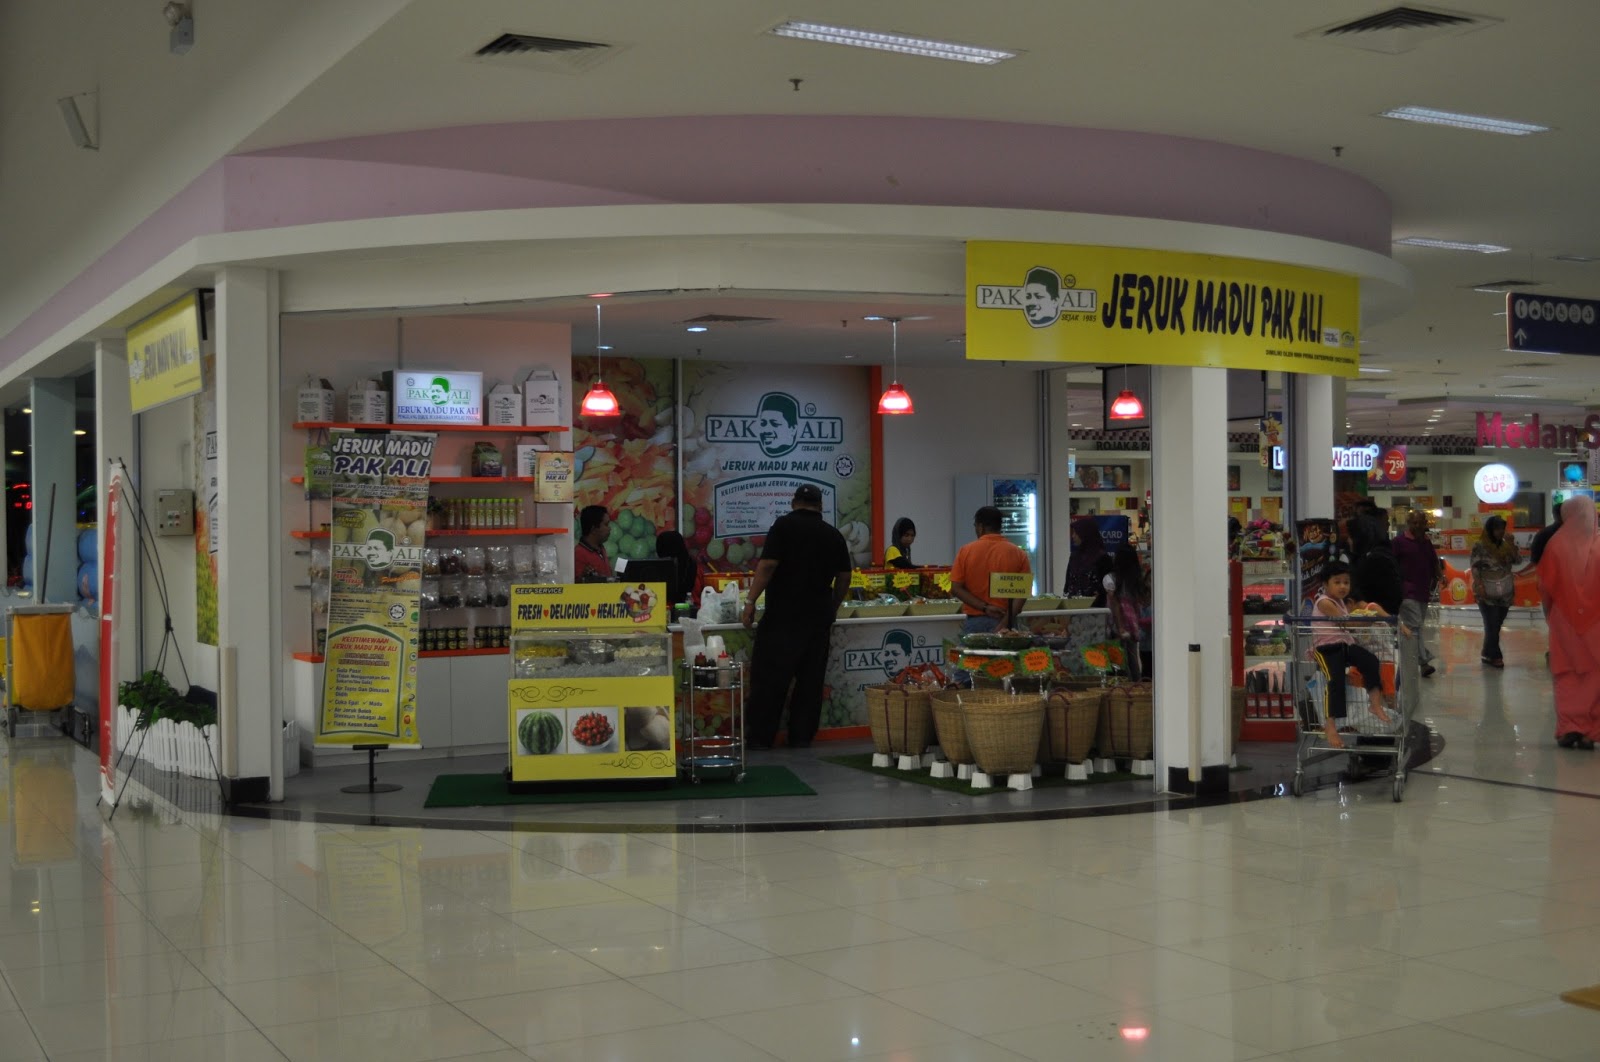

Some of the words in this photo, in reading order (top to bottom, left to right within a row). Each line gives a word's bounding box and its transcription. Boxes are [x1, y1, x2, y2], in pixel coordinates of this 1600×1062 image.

[982, 288, 1023, 305] PAK
[1061, 291, 1095, 308] ALI
[1102, 273, 1188, 336] JERUK
[1192, 279, 1256, 336] MADU
[1260, 286, 1295, 344] PAK
[1298, 292, 1323, 344] ALI
[1061, 314, 1079, 322] SEJAK
[408, 389, 430, 399] PAK
[450, 390, 469, 400] ALI
[397, 405, 421, 414] JERUK
[423, 406, 448, 415] MADU
[450, 407, 465, 415] PAK
[466, 407, 479, 415] ALI
[710, 419, 757, 438] PAK
[800, 421, 837, 439] ALI
[1475, 410, 1578, 449] Medan
[332, 438, 383, 455] JERUK
[386, 440, 433, 457] MADU
[1096, 441, 1130, 450] ROJAK
[1131, 441, 1139, 450] &
[334, 456, 384, 476] PAK
[389, 458, 430, 477] ALI
[722, 461, 756, 471] JERUK
[757, 461, 788, 471] MADU
[791, 461, 810, 471] PAK
[812, 461, 828, 472] ALI
[1332, 450, 1372, 468] Waffle
[720, 481, 767, 497] KEISTIMEWAAN
[1484, 481, 1505, 493] CUP
[333, 545, 364, 558] PAK
[396, 549, 422, 560] ALI
[517, 604, 542, 621] FRESH
[550, 603, 590, 619] DELICIOUS
[597, 603, 630, 619] HEALTHY
[342, 636, 389, 644] KEISTIMEWAAN
[847, 651, 882, 668] PAK
[914, 649, 940, 664] ALI
